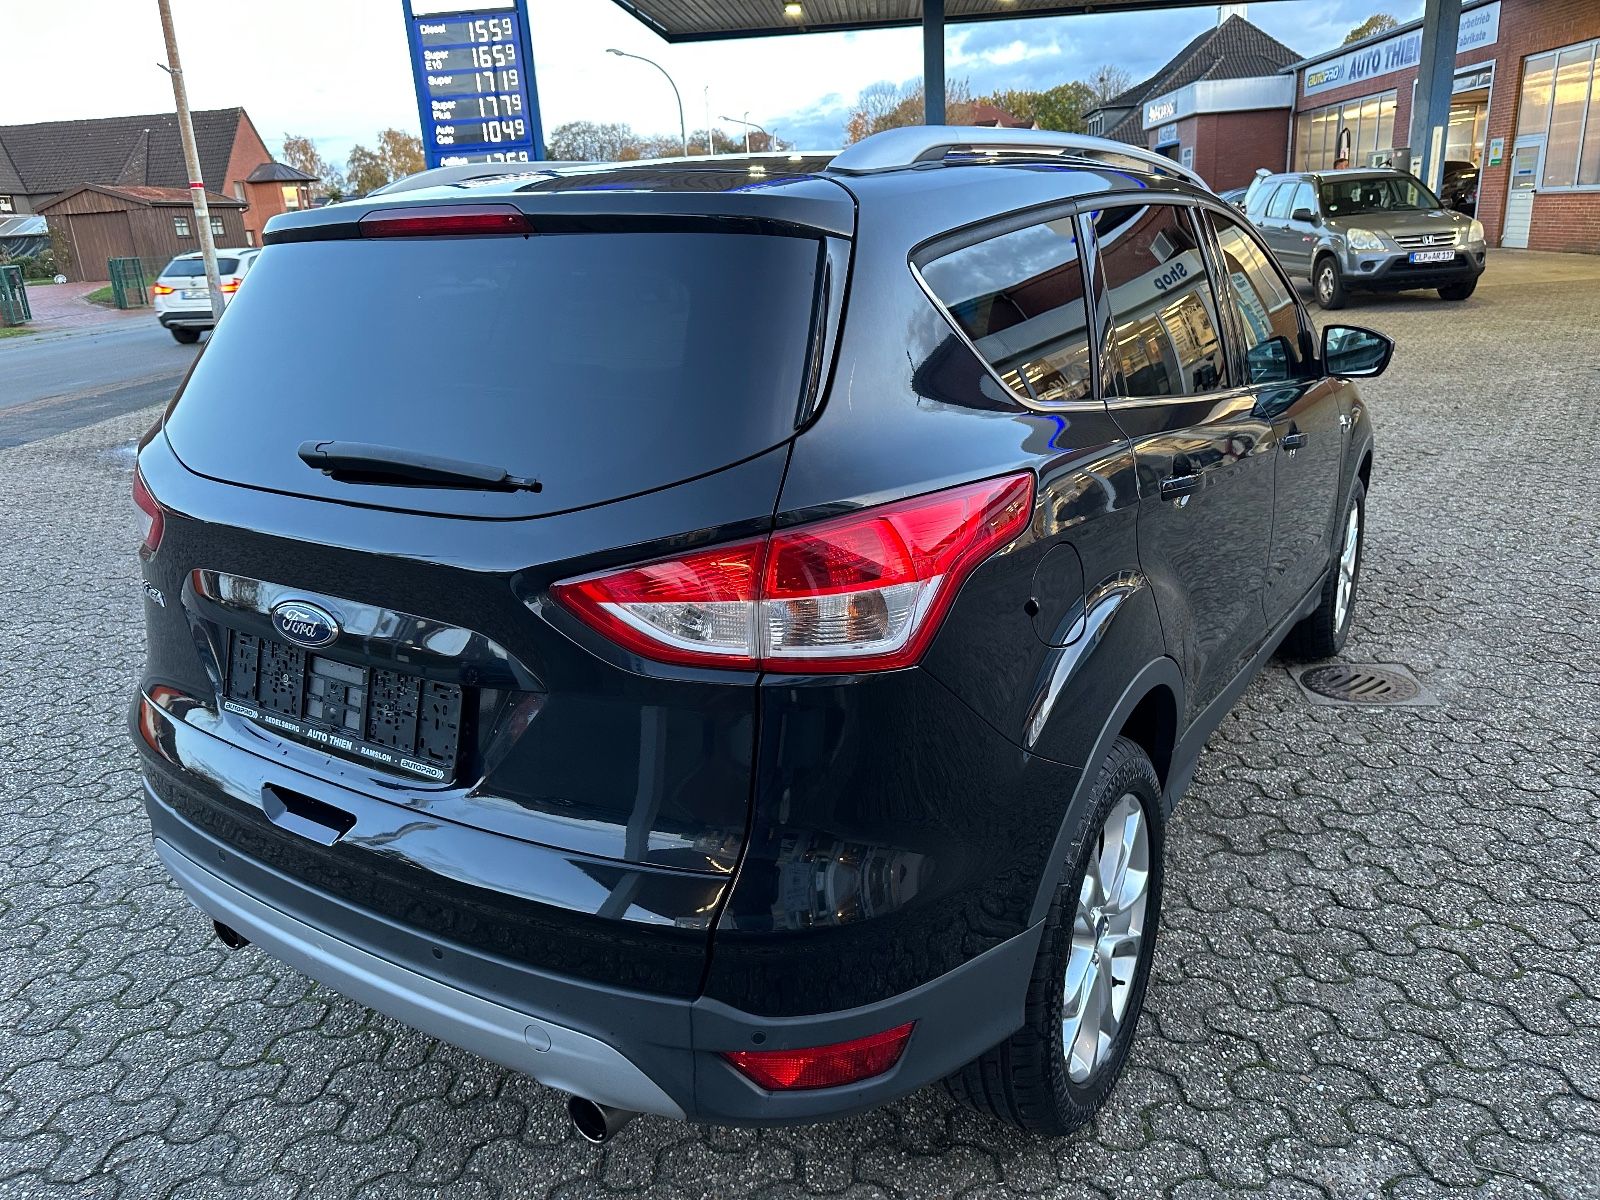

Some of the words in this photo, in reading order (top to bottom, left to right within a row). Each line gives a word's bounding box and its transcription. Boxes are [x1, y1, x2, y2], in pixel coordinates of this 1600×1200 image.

[420, 24, 446, 35] Diesel
[469, 18, 512, 42] 1559
[424, 50, 449, 60] Super
[472, 44, 515, 68] 1659
[425, 60, 443, 71] E10
[1348, 49, 1381, 80] AUTO
[428, 75, 453, 86] Super
[475, 69, 518, 93] 1719
[431, 100, 456, 111] Super
[478, 94, 522, 118] 1779
[432, 110, 451, 121] Plus
[436, 125, 455, 135] Auto
[482, 119, 525, 143] 1049
[436, 135, 455, 145] Gas
[282, 609, 318, 638] Ford
[264, 715, 300, 733] SEDELSBERG
[307, 728, 328, 742] AUTO
[329, 735, 353, 751] THIEN
[360, 746, 391, 762] RAMSLOH
